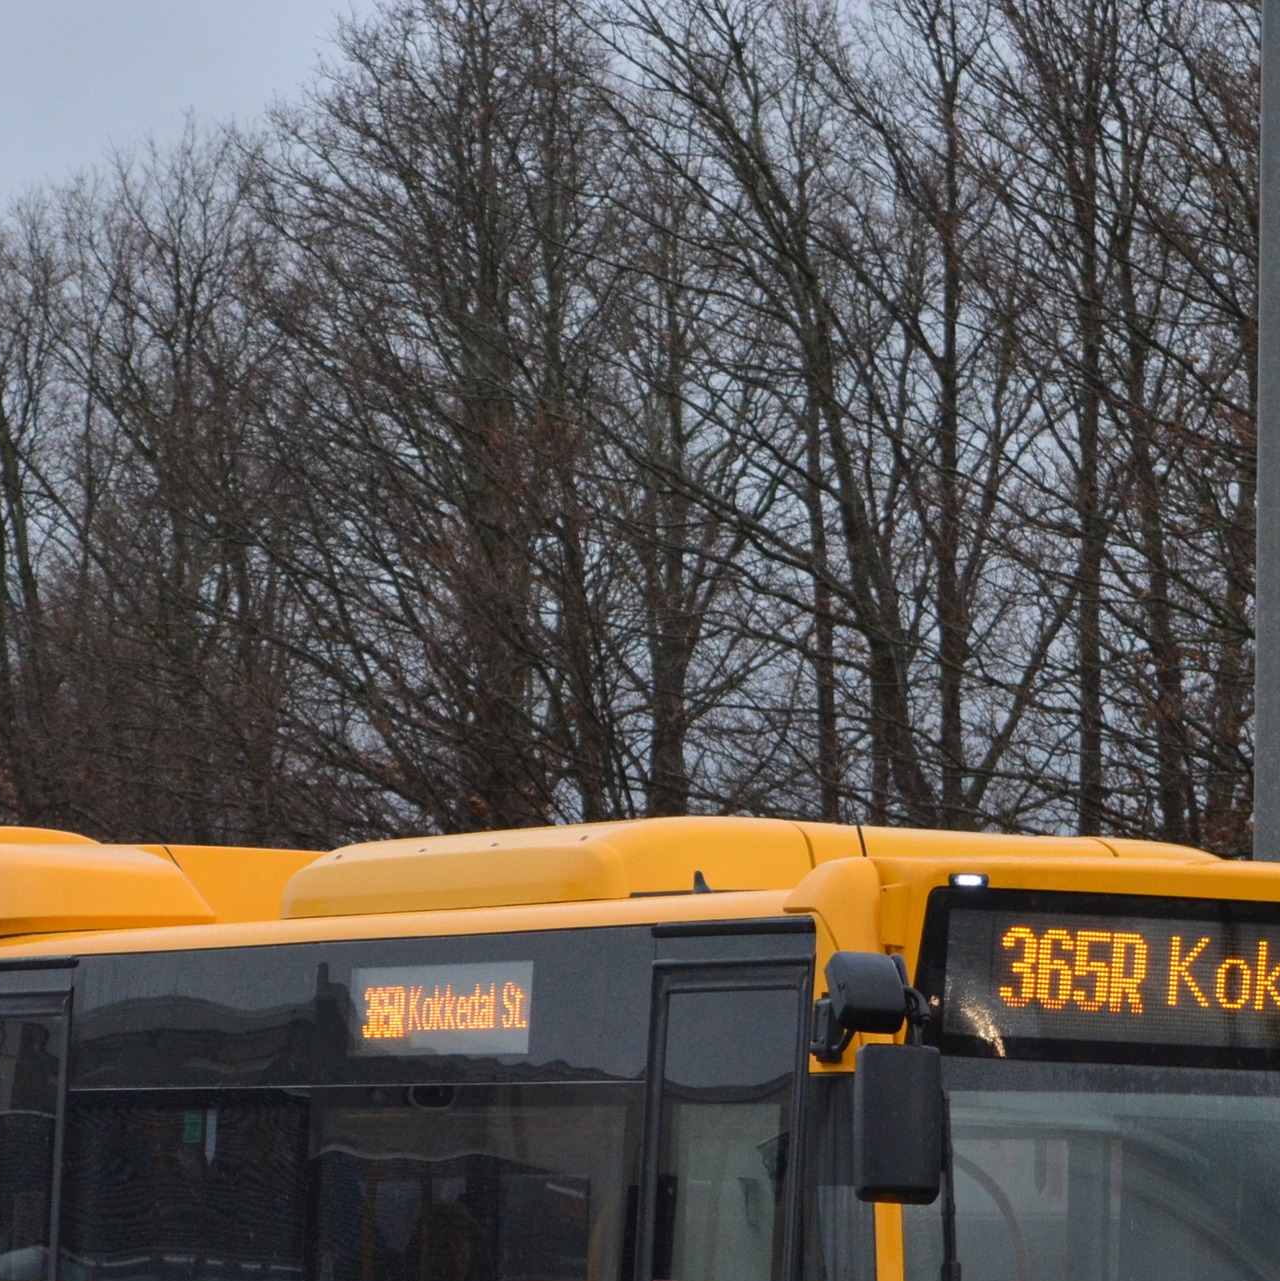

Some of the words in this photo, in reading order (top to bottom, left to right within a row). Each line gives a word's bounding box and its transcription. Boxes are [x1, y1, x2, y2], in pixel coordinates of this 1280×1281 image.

[999, 926, 1148, 1013] 365R
[408, 983, 496, 1030] Kokkedal
[501, 982, 529, 1029] St.
